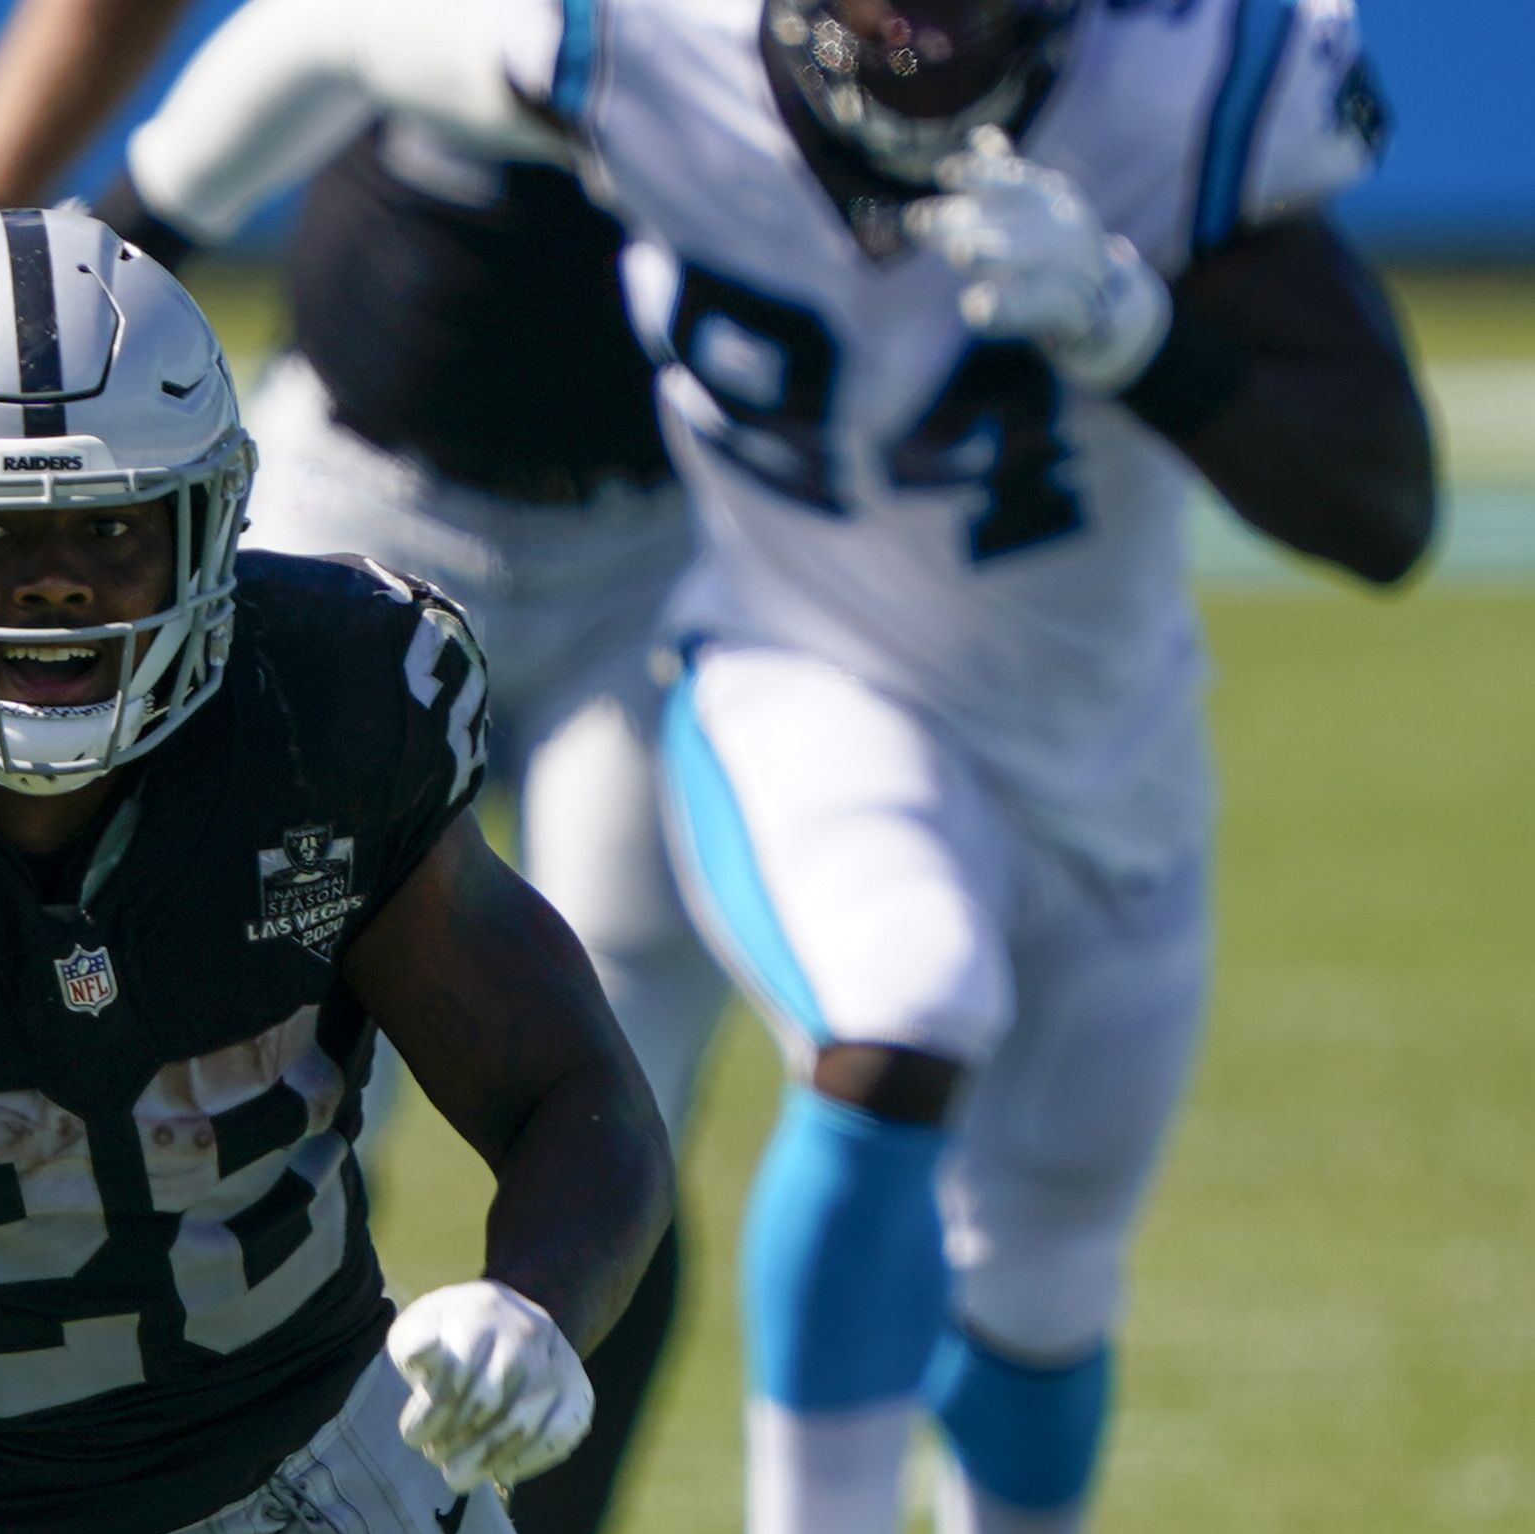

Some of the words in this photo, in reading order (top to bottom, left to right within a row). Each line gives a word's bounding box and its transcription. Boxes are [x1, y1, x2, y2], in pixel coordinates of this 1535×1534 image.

[671, 260, 1088, 565] 94
[3, 455, 83, 471] RAIDERS
[268, 884, 344, 916] SEASON
[247, 917, 293, 941] LAS
[295, 895, 364, 933] VEGAS
[302, 916, 346, 947] 2020
[69, 975, 109, 1003] NFL
